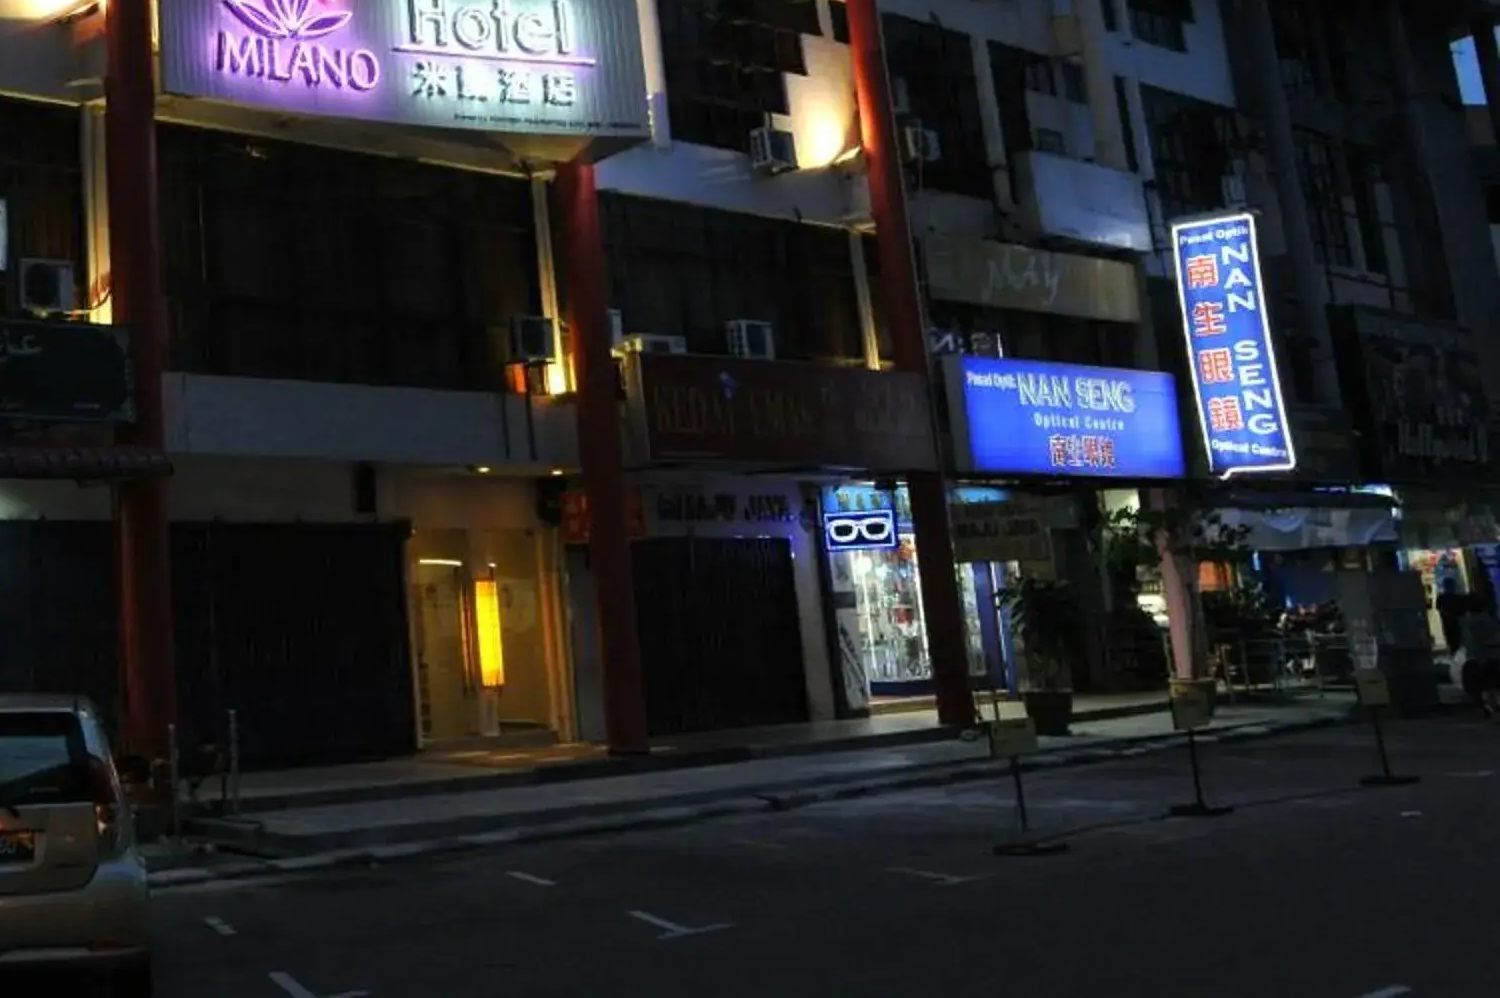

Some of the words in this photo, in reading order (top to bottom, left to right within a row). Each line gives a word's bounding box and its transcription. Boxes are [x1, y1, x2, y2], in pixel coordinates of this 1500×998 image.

[215, 30, 381, 91] MILANO
[1220, 242, 1257, 313] NAN
[1016, 372, 1073, 409] NAN
[1074, 377, 1136, 413] SENG
[1232, 339, 1279, 435] SENG
[1033, 411, 1080, 431] Optical
